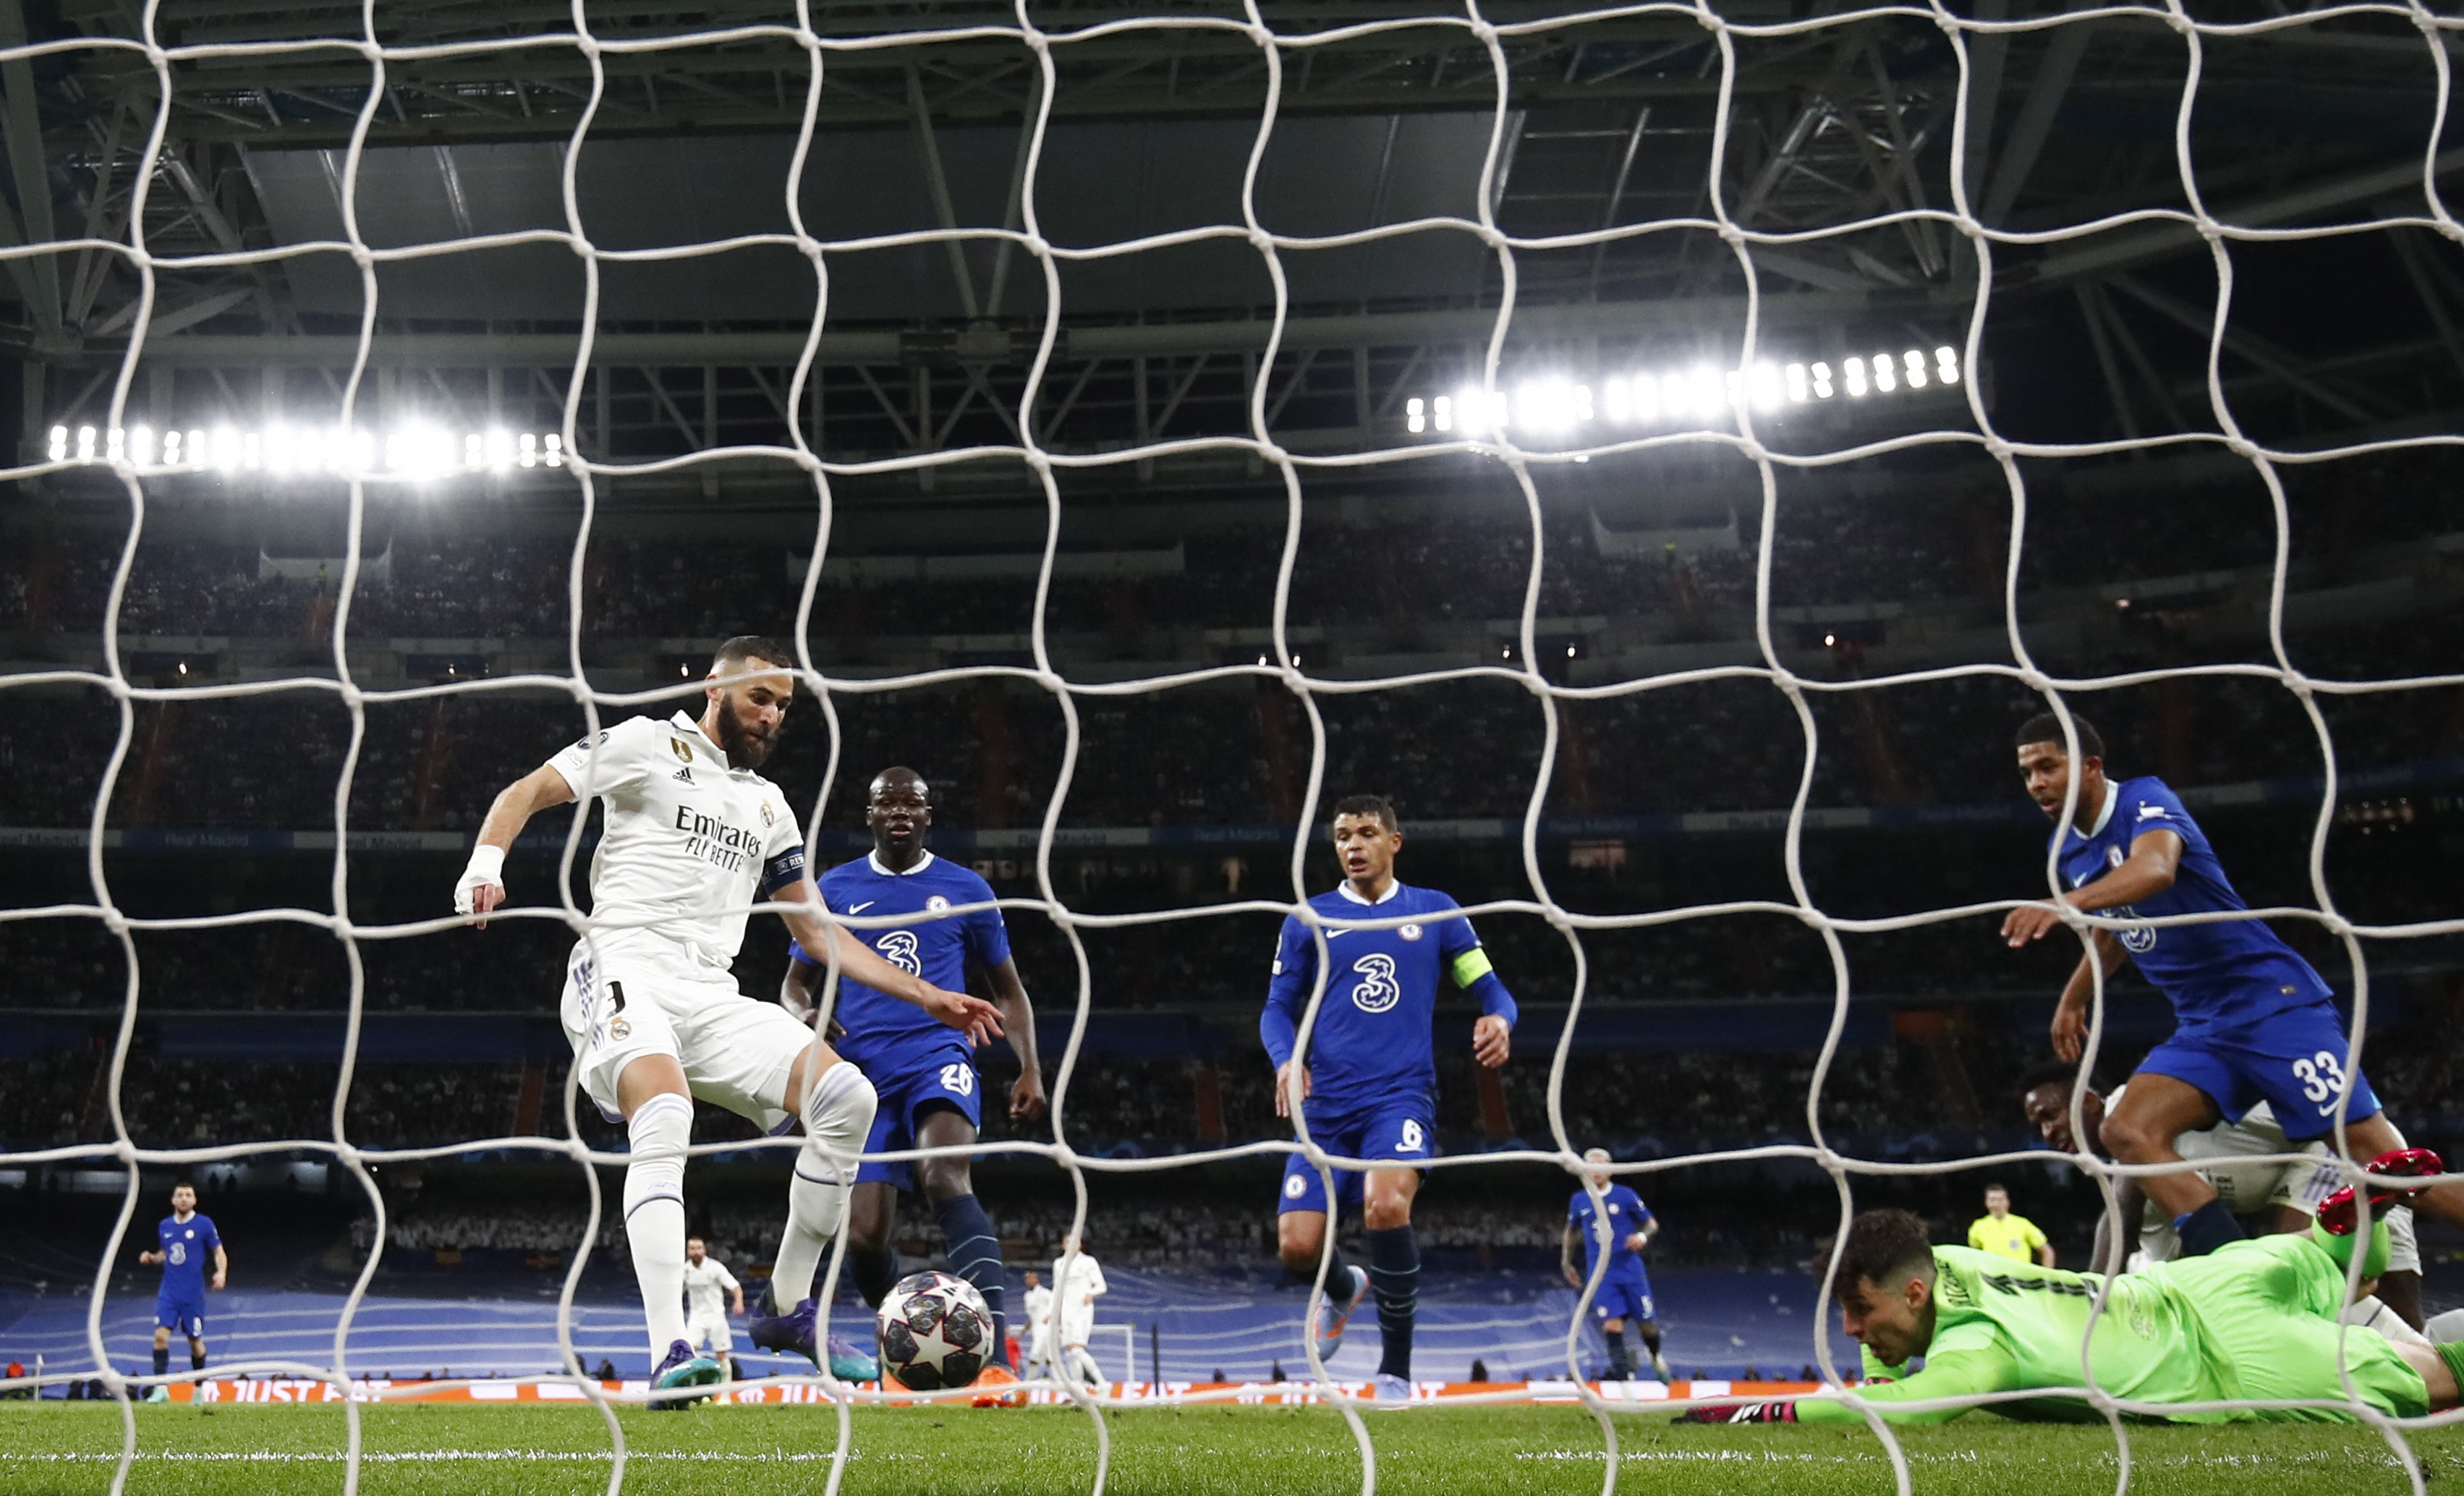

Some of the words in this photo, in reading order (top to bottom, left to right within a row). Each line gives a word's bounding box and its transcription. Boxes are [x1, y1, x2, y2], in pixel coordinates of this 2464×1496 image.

[676, 804, 762, 857] Emirates
[685, 836, 710, 858] FLY
[710, 845, 745, 872] BETTE
[940, 1062, 974, 1096] 26
[2293, 1050, 2347, 1102] 33
[1402, 1118, 1424, 1149] 6
[233, 1380, 317, 1403] JUST
[1410, 1380, 1445, 1403] AT
